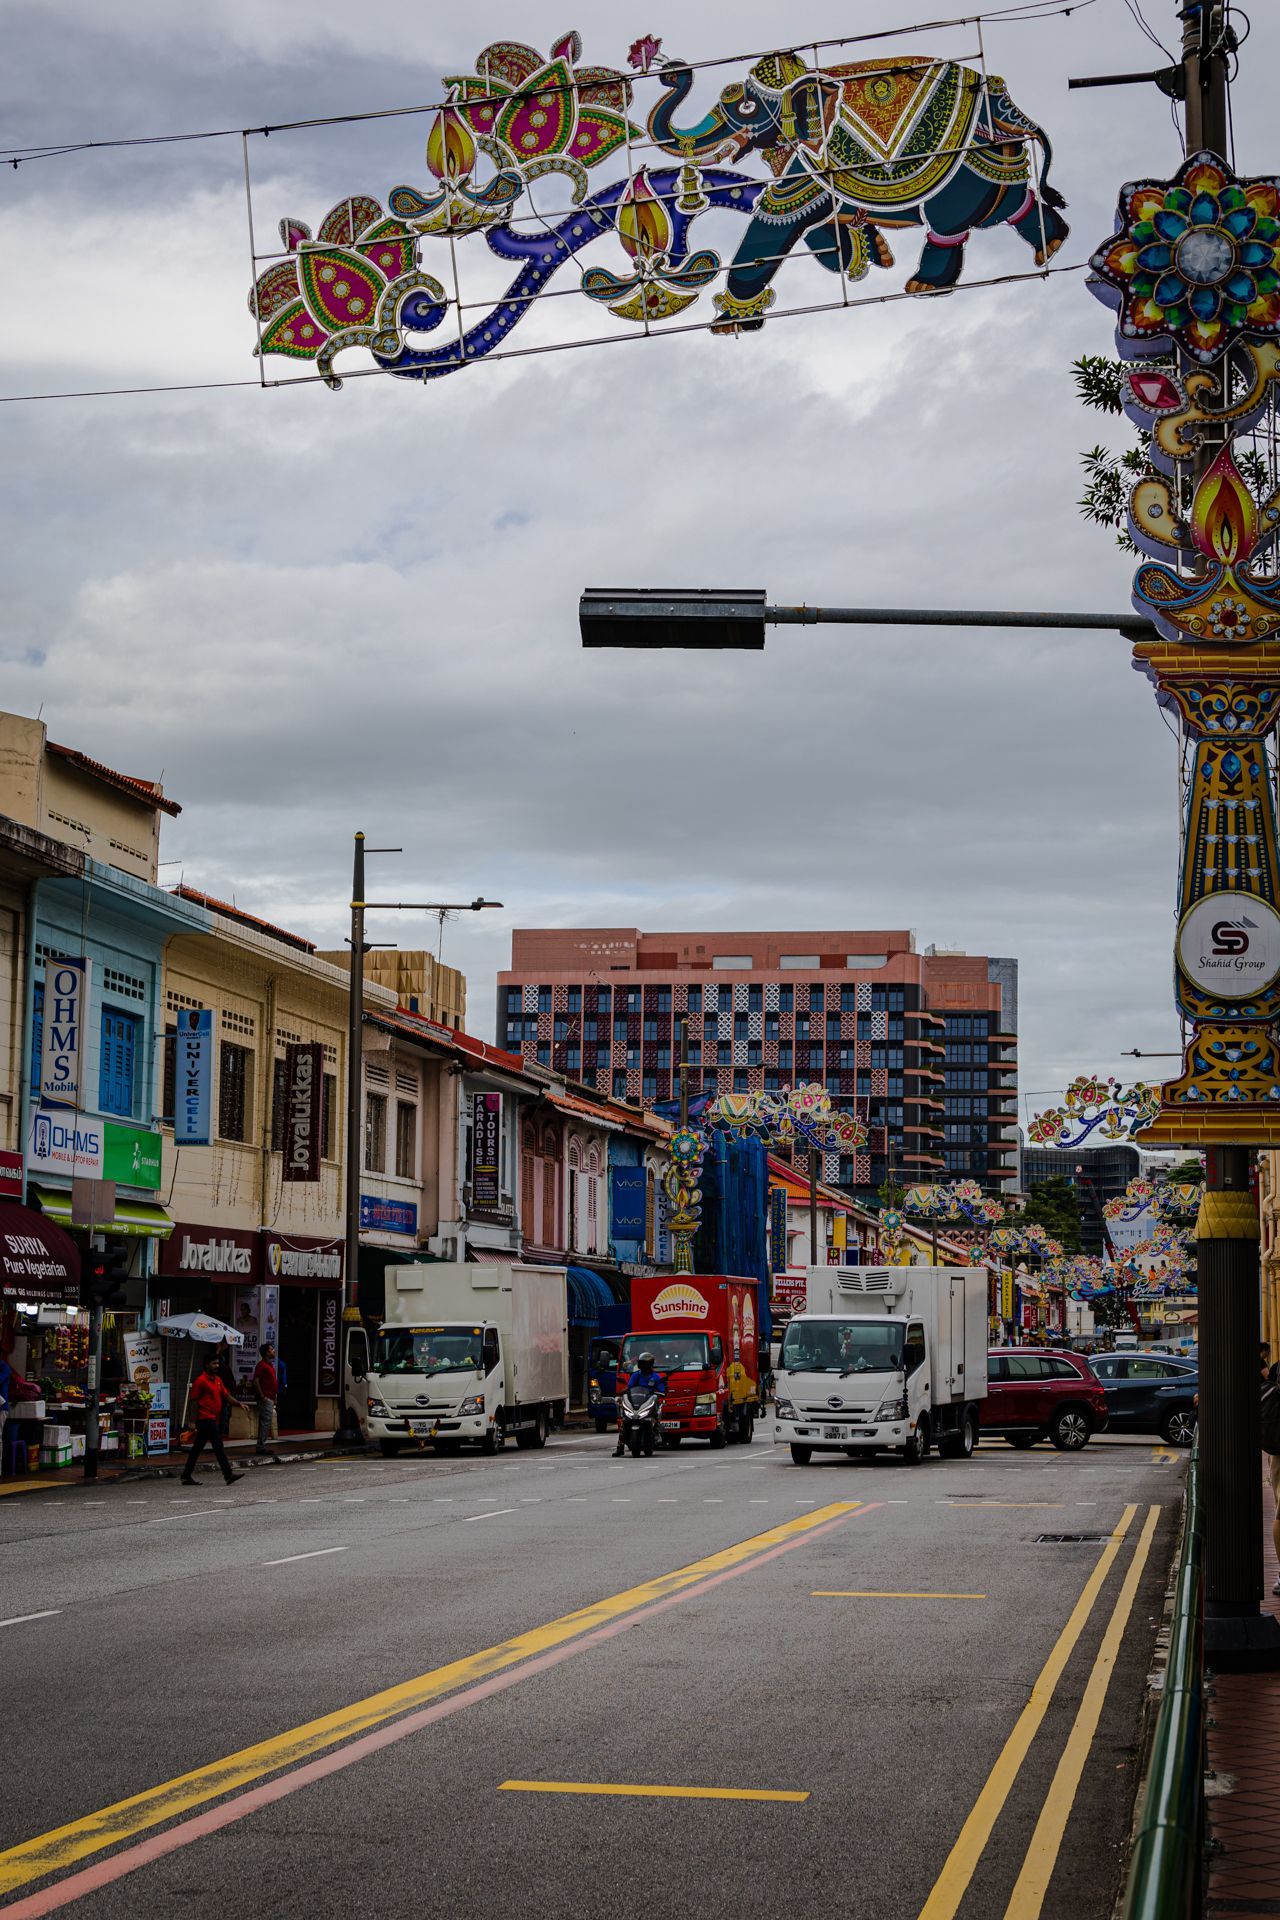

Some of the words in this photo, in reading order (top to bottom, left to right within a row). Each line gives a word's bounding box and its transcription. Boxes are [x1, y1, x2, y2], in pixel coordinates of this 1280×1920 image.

[1198, 956, 1233, 969] Shahid
[1234, 956, 1266, 971] Group
[49, 969, 78, 1081] OHMS
[43, 1082, 79, 1092] Mobile
[186, 1042, 200, 1134] UNIVERCELL
[290, 1054, 314, 1171] Joyalukkas
[52, 1126, 99, 1154] OHMS
[475, 1095, 485, 1165] PARADISE
[486, 1112, 496, 1156] TOURS
[616, 1179, 642, 1188] vivo
[615, 1215, 642, 1225] vivo
[4, 1234, 50, 1257] SURIYA
[180, 1235, 251, 1273] Joyalukkas
[2, 1256, 25, 1274] Pure
[23, 1258, 68, 1280] Vegetarian
[653, 1300, 707, 1315] Sunshine
[323, 1299, 337, 1371] Joyalukkas
